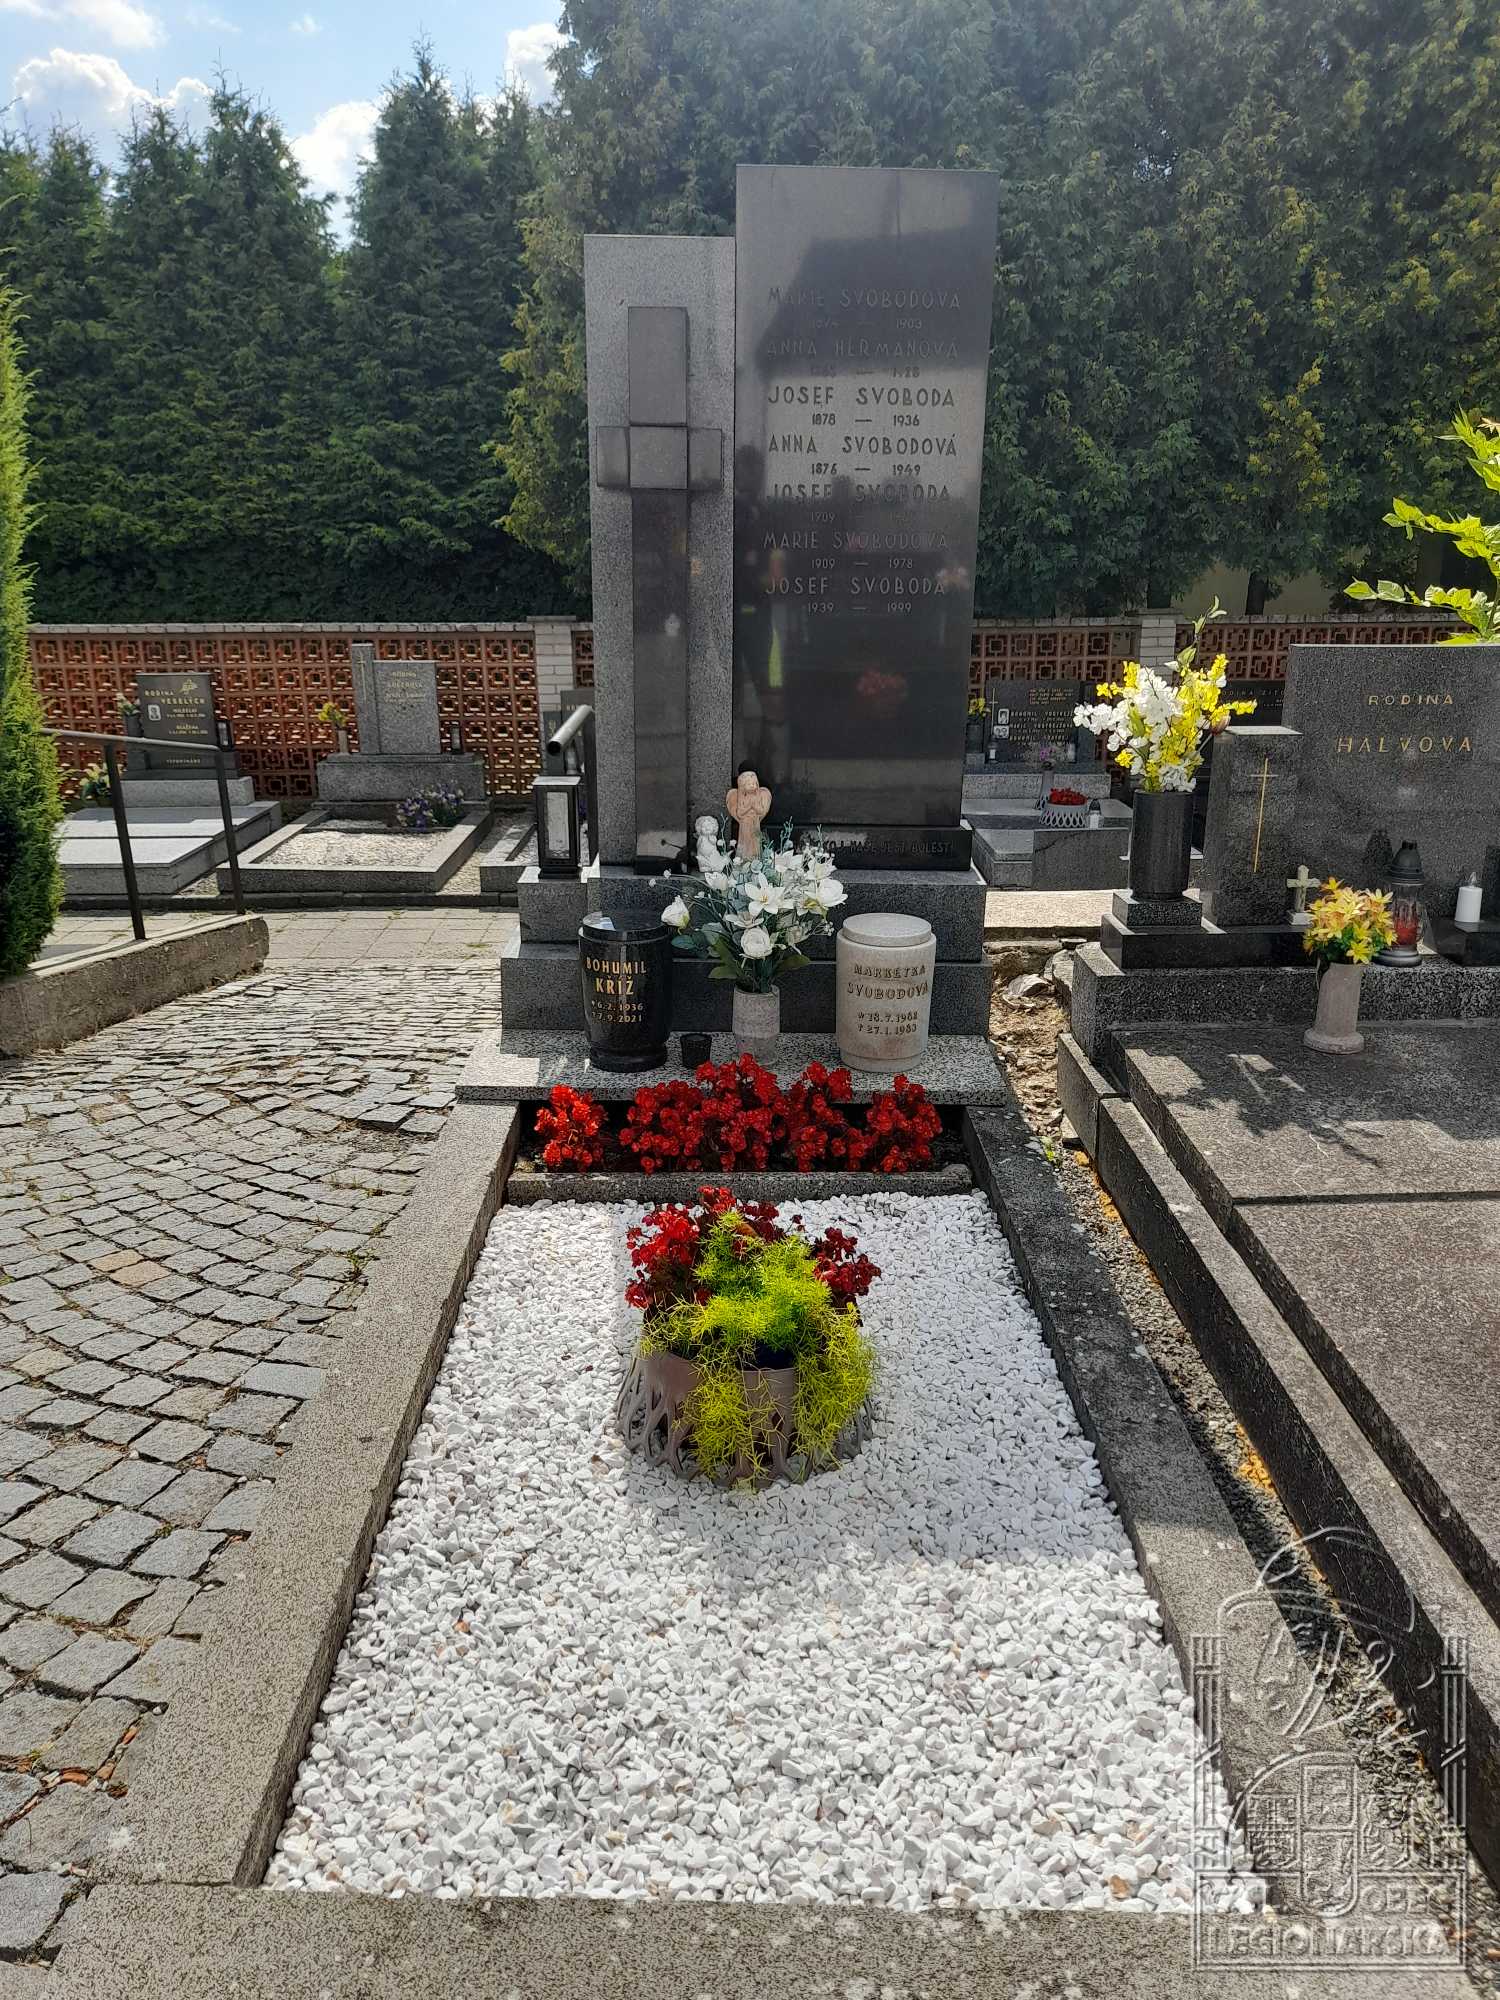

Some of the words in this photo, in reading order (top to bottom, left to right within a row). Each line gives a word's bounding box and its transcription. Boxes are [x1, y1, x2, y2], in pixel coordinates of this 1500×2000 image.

[768, 339, 817, 358] ANNA
[768, 386, 834, 405] JOSEF
[856, 386, 955, 407] SVOBODA
[811, 413, 836, 427] 1878
[893, 413, 920, 427] 1936
[768, 434, 818, 455] ANNA
[841, 432, 959, 456] SVOBODOVÁ
[811, 462, 838, 476] 1876
[892, 463, 922, 477] 1949
[767, 483, 833, 503] JOSEF
[762, 530, 819, 550] MARIE
[811, 557, 836, 570] 1909
[888, 557, 914, 570] 1978
[765, 576, 830, 596] JOSEF
[849, 576, 946, 596] SVOBODA
[807, 601, 834, 614] 1939
[887, 601, 913, 614] 1999
[1368, 694, 1454, 705] RODINA
[1336, 736, 1474, 753] HALVOVA
[586, 956, 647, 975] BOHUMIL
[595, 975, 635, 996] KŘÍŽ
